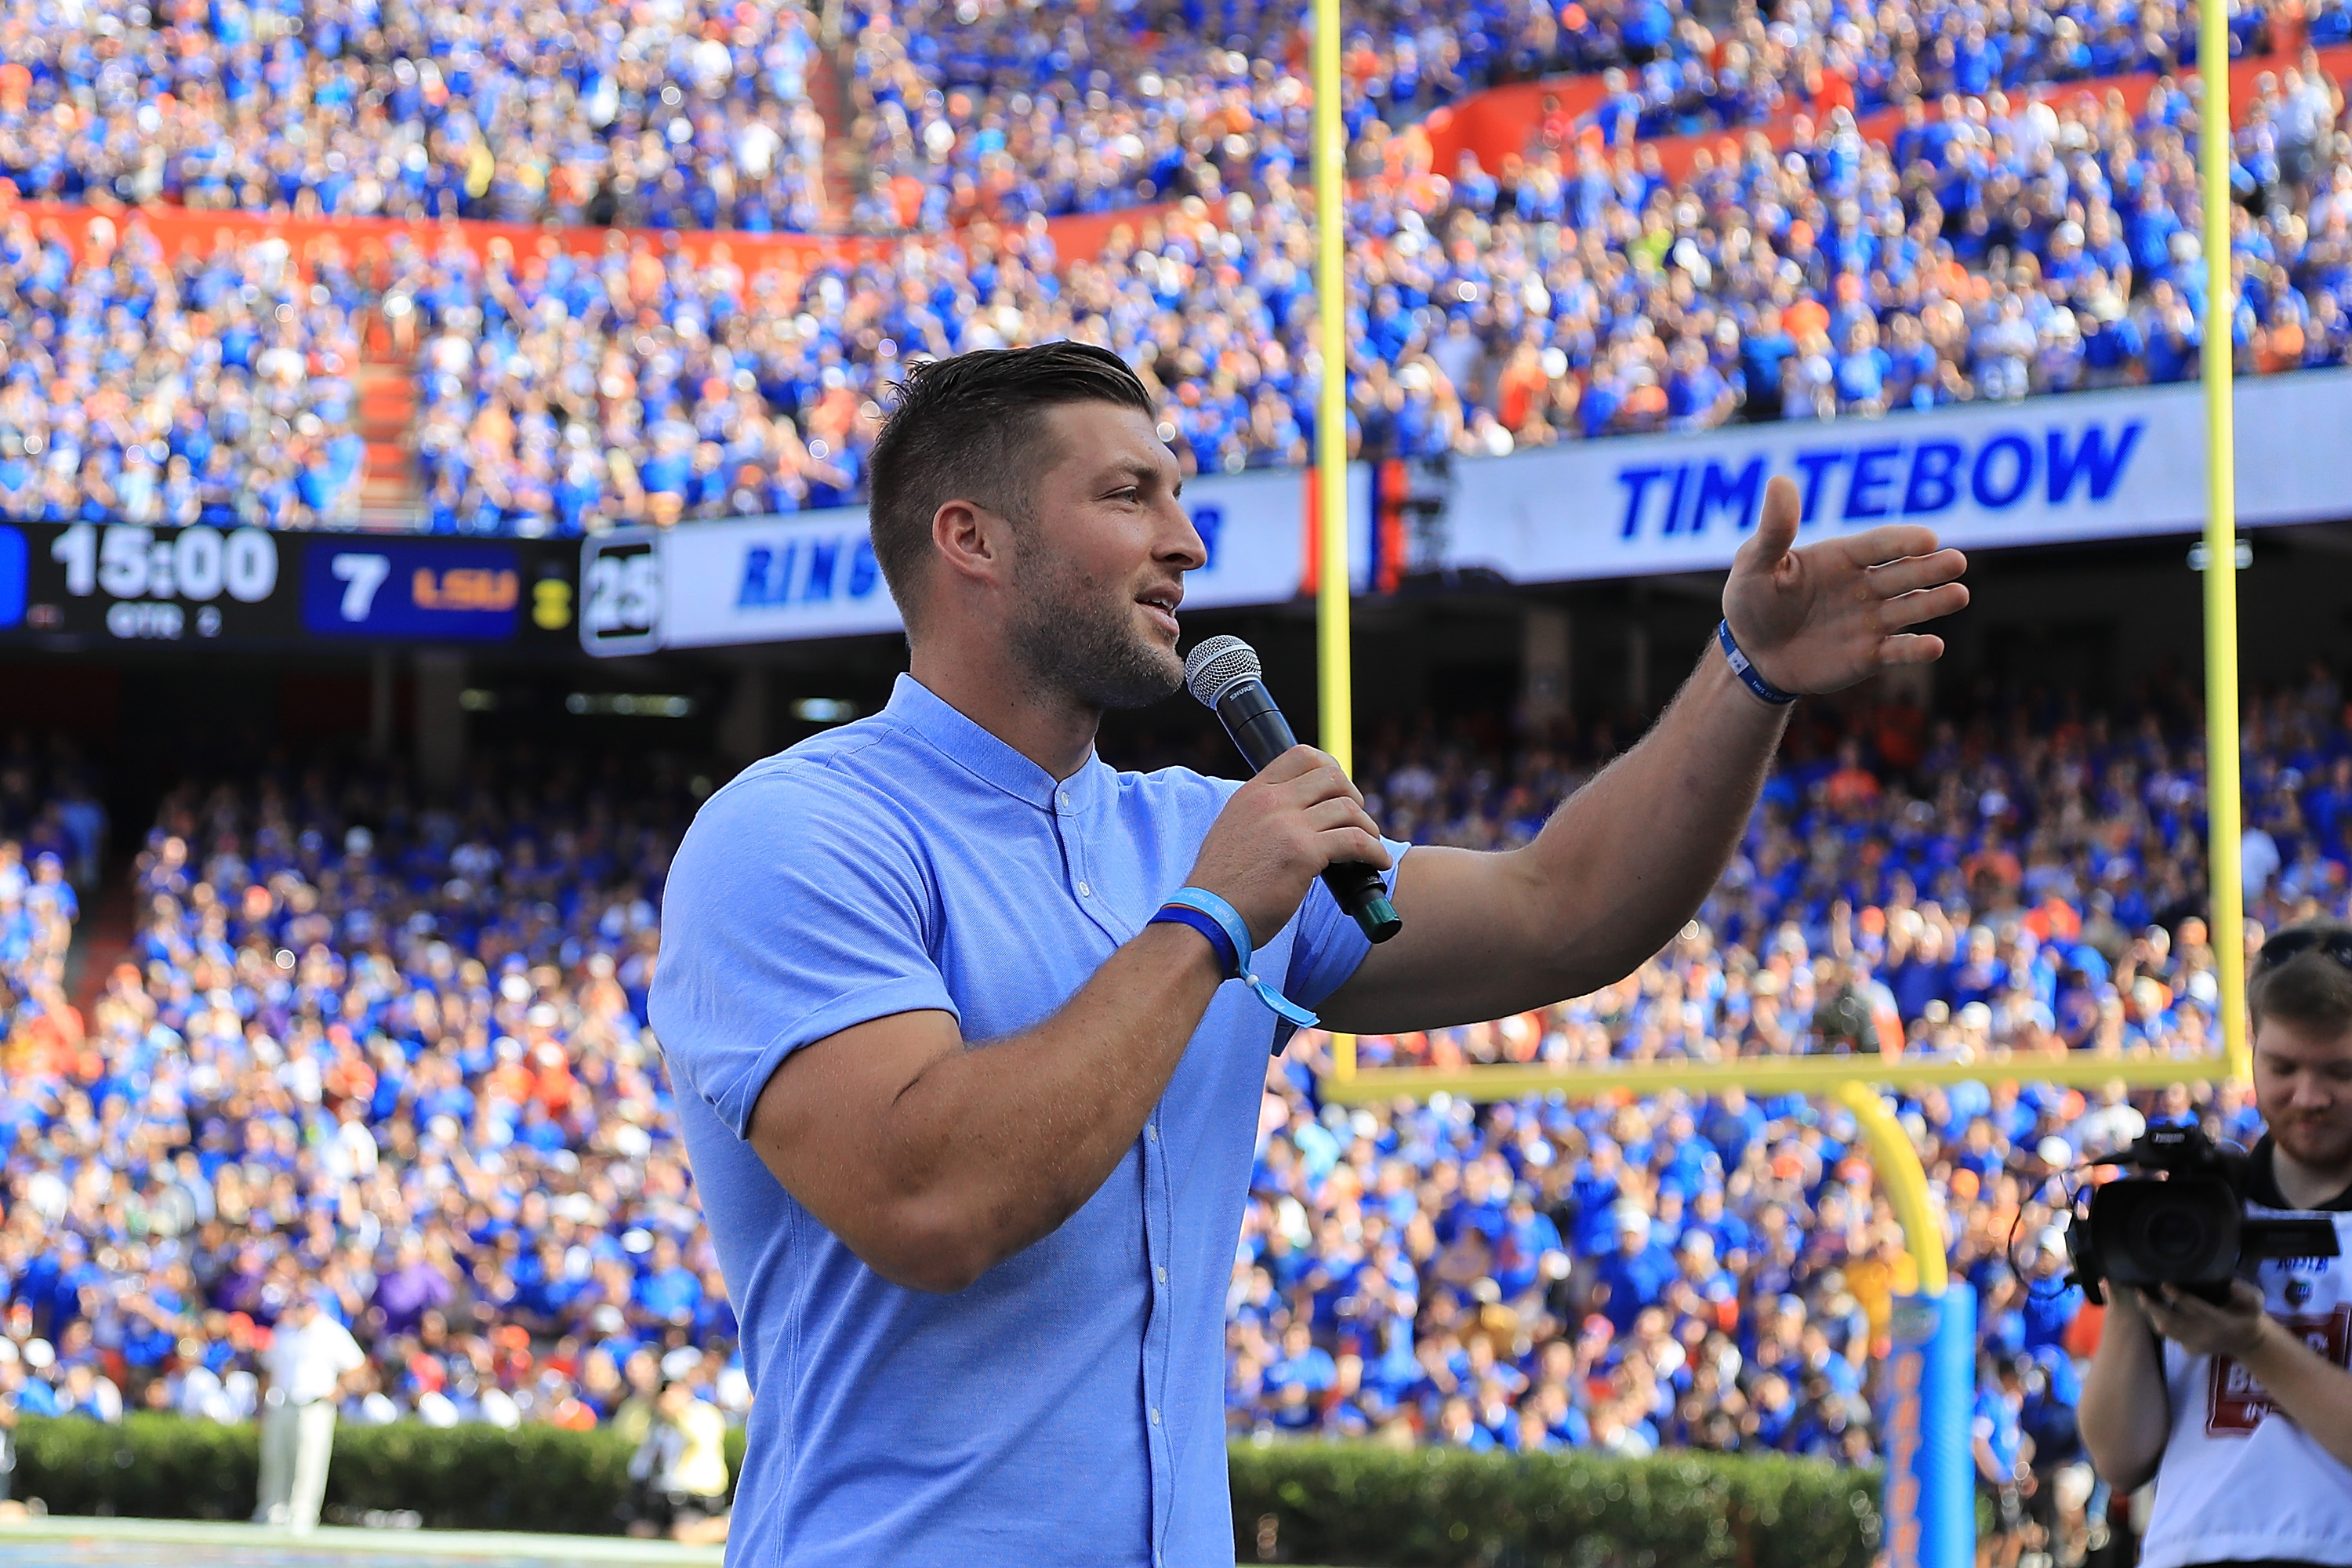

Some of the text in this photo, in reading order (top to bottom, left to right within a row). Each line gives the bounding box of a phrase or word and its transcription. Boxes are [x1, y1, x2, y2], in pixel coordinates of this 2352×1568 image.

[1618, 420, 2150, 539] TIM TEBOW
[51, 521, 279, 603] 15:00
[331, 552, 391, 622] 7
[412, 567, 520, 612] LSU
[1229, 684, 1254, 702] SHURE
[1752, 680, 1766, 694] THIS
[1189, 892, 1209, 905] Hope
[1214, 903, 1235, 924] Faith
